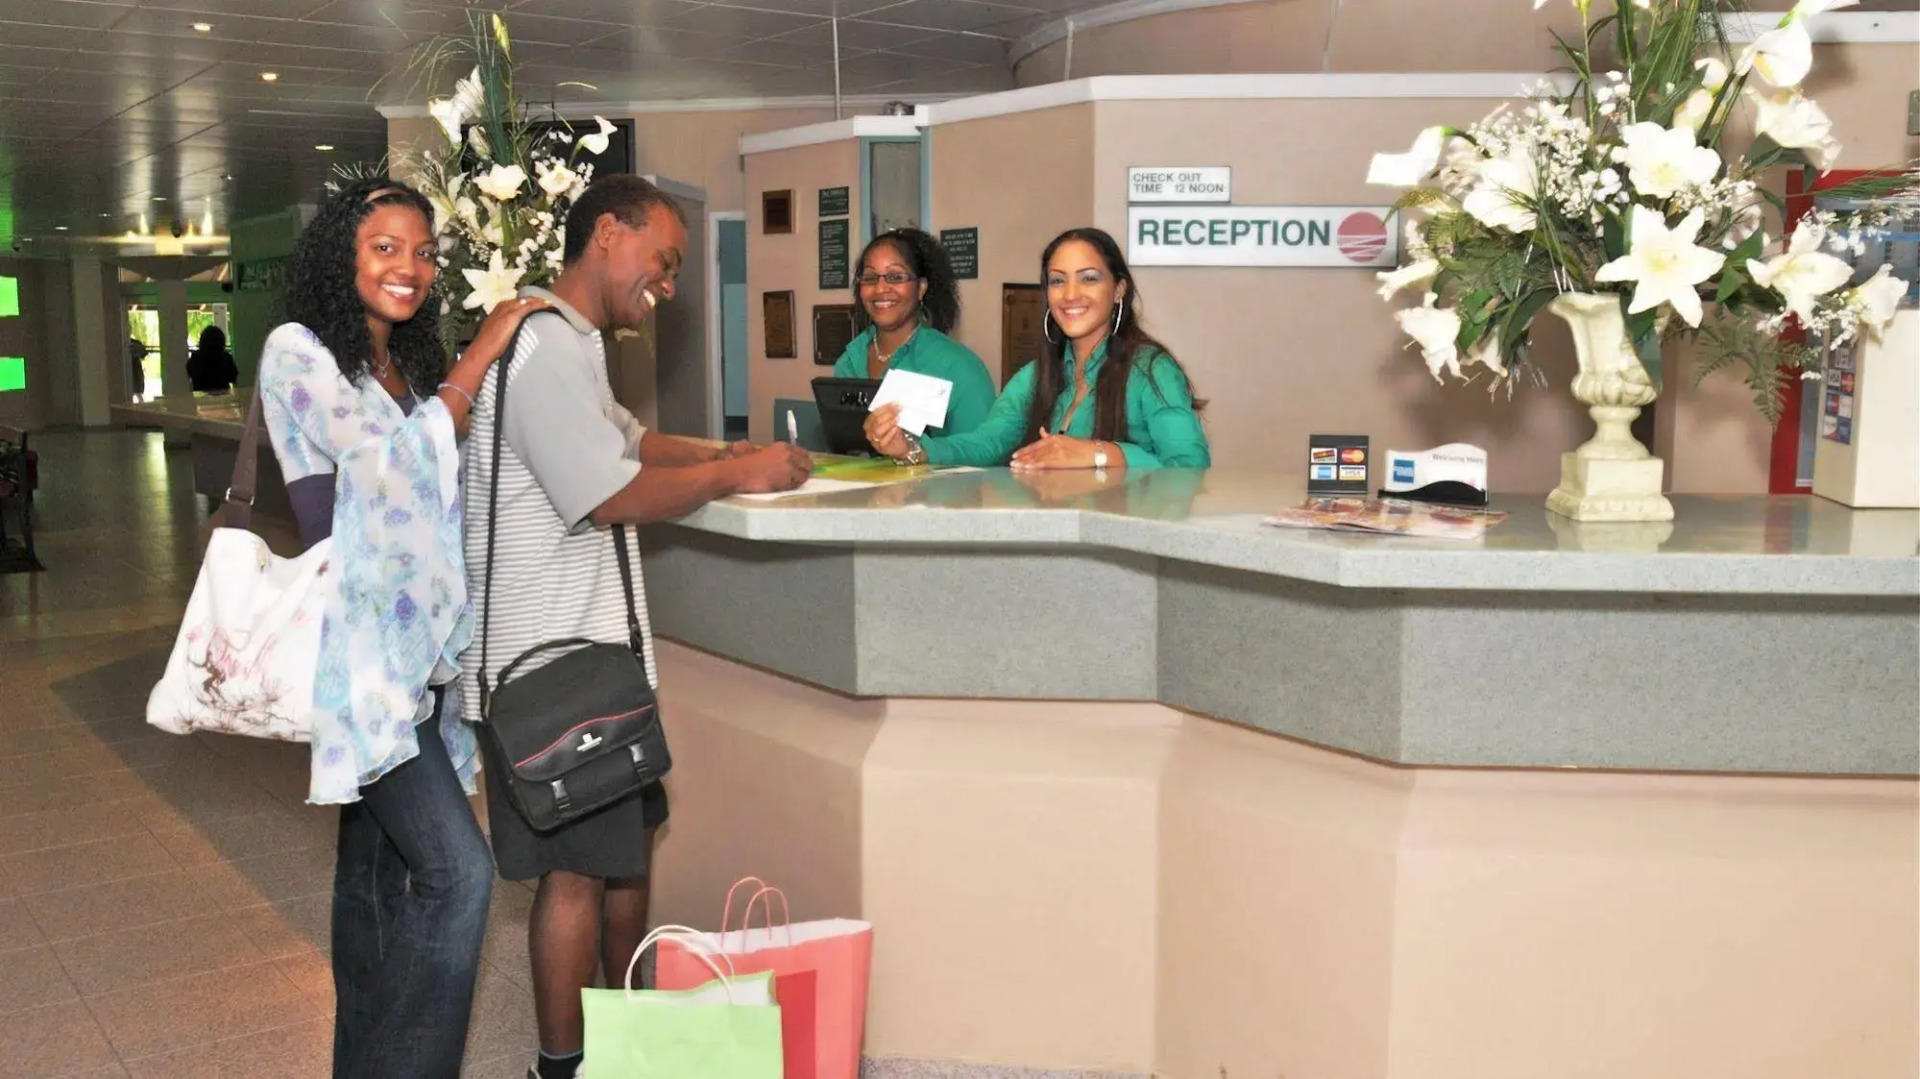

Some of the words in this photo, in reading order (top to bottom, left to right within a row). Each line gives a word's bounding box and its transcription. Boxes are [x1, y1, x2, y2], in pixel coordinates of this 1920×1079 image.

[1132, 172, 1175, 183] CHECK
[1178, 172, 1203, 183] OUT
[1134, 183, 1163, 193] TIME
[1174, 183, 1186, 193] 12
[1188, 183, 1225, 193] NOON
[1137, 219, 1331, 247] RECEPTION
